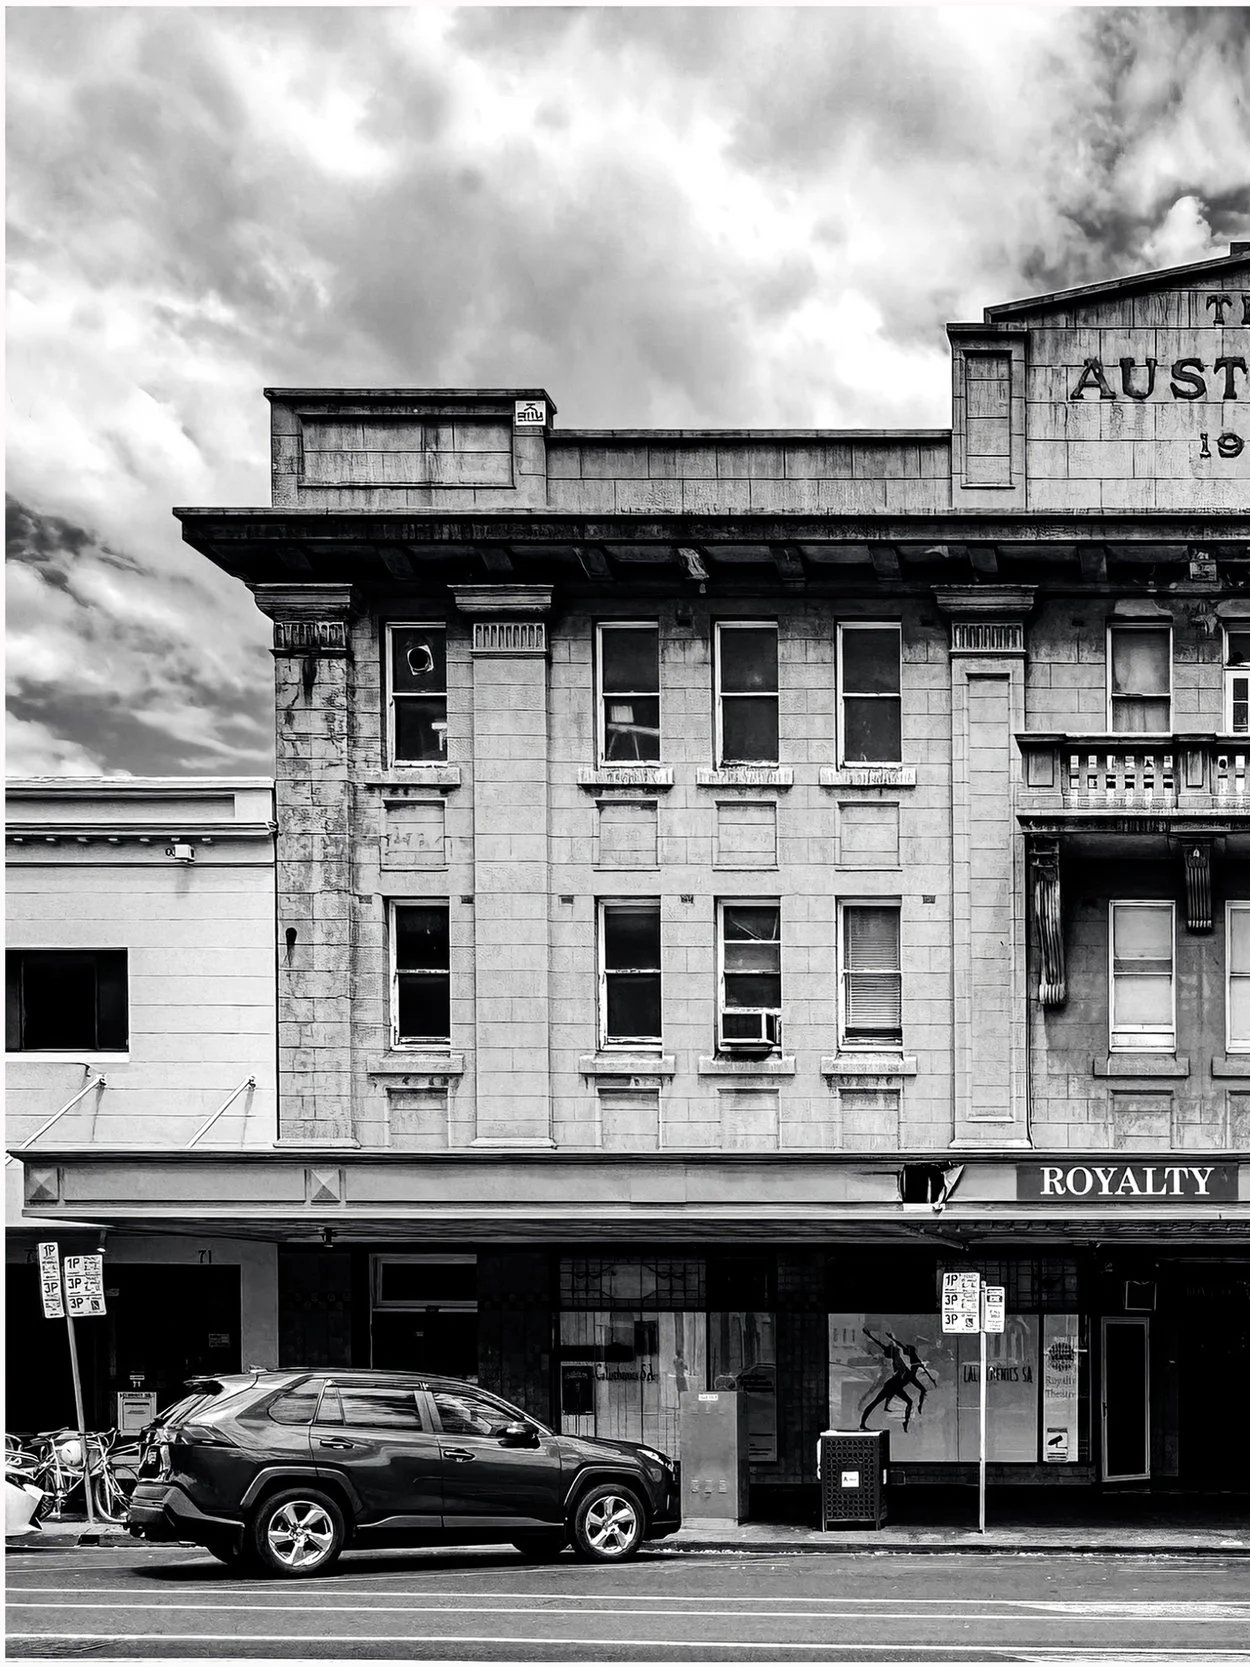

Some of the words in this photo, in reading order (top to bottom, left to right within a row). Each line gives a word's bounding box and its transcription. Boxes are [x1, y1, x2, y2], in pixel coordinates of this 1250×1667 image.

[1039, 1166, 1215, 1196] ROYALTY
[44, 1245, 56, 1257] 1P
[199, 1250, 213, 1264] 71
[67, 1257, 80, 1269] 1P
[945, 1274, 958, 1286] 1P
[69, 1297, 84, 1309] 3P
[945, 1294, 958, 1306] 3P
[945, 1314, 958, 1325] 3P
[1022, 1365, 1034, 1383] SA
